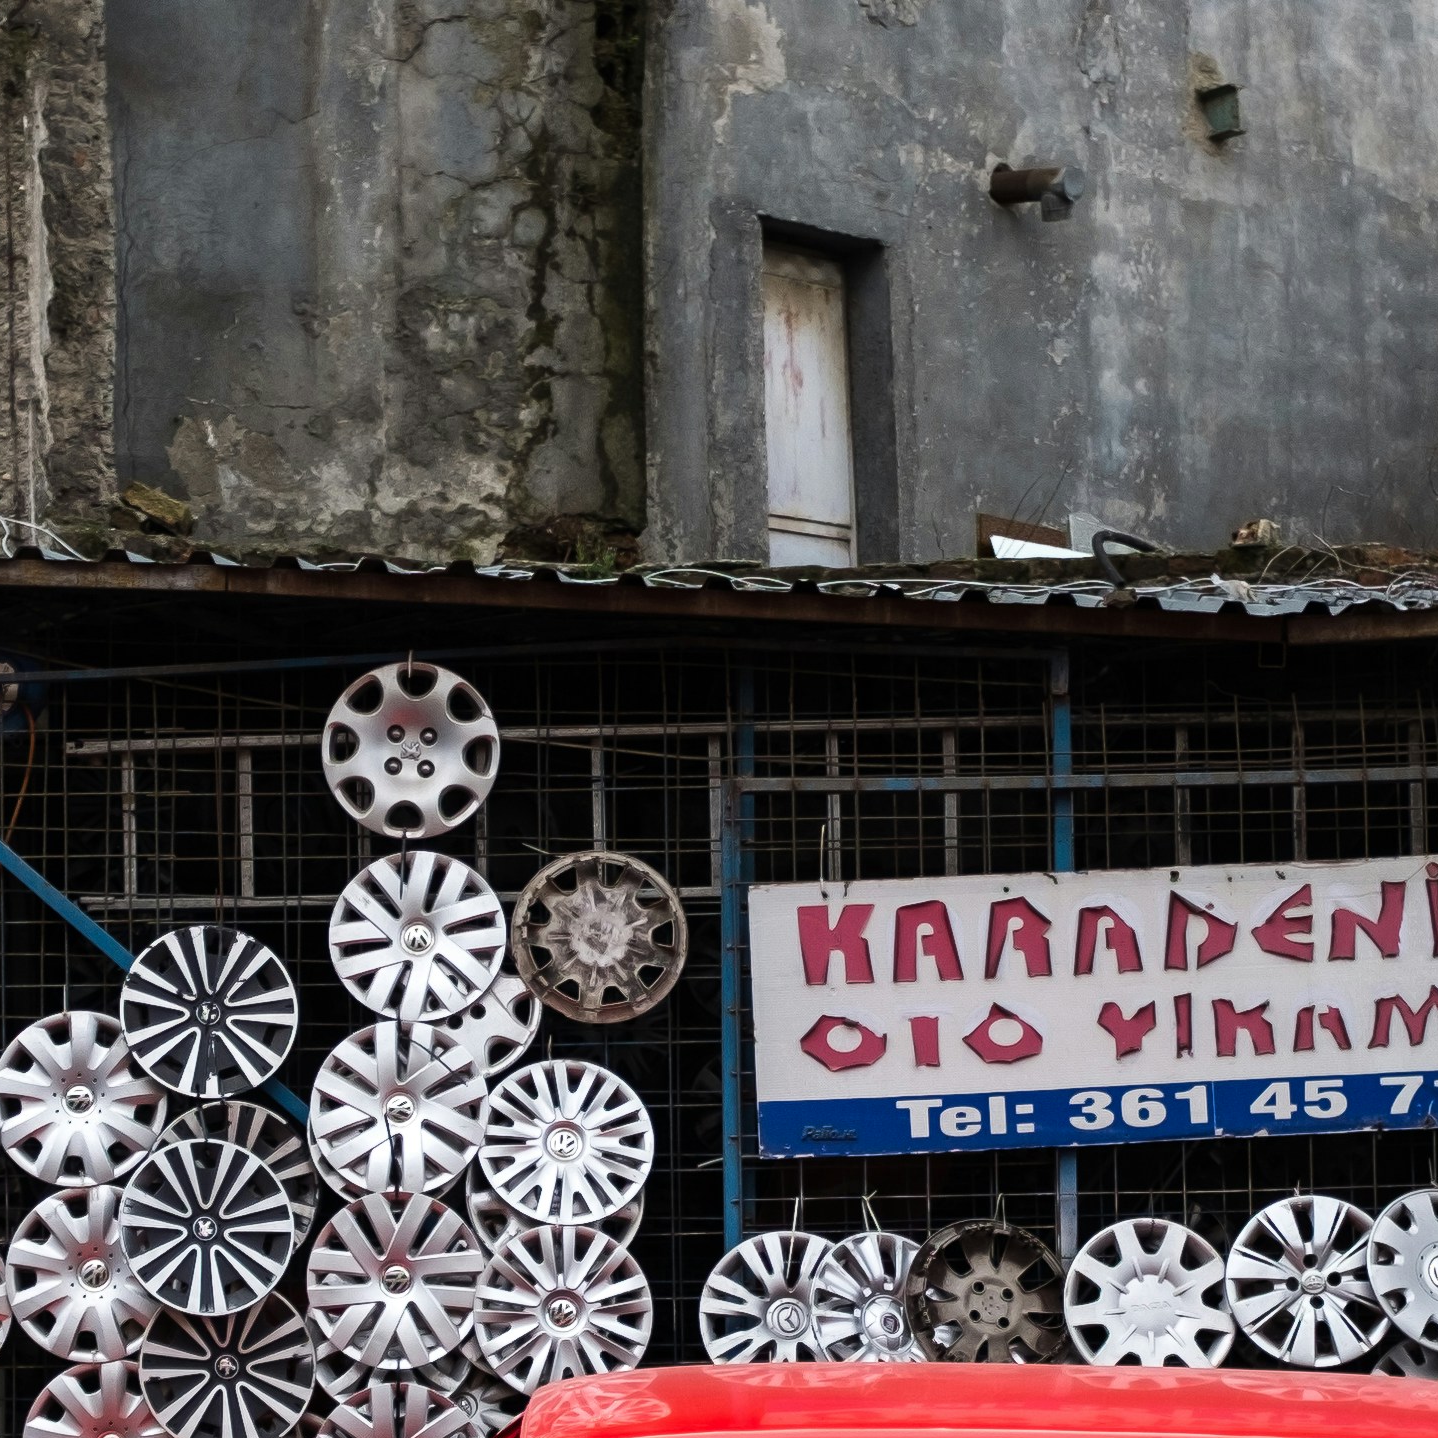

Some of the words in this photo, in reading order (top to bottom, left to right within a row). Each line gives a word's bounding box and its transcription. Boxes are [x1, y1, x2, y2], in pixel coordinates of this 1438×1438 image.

[896, 1095, 1036, 1138] Tel:
[1069, 1085, 1209, 1130] 361
[1250, 1078, 1348, 1120] 45
